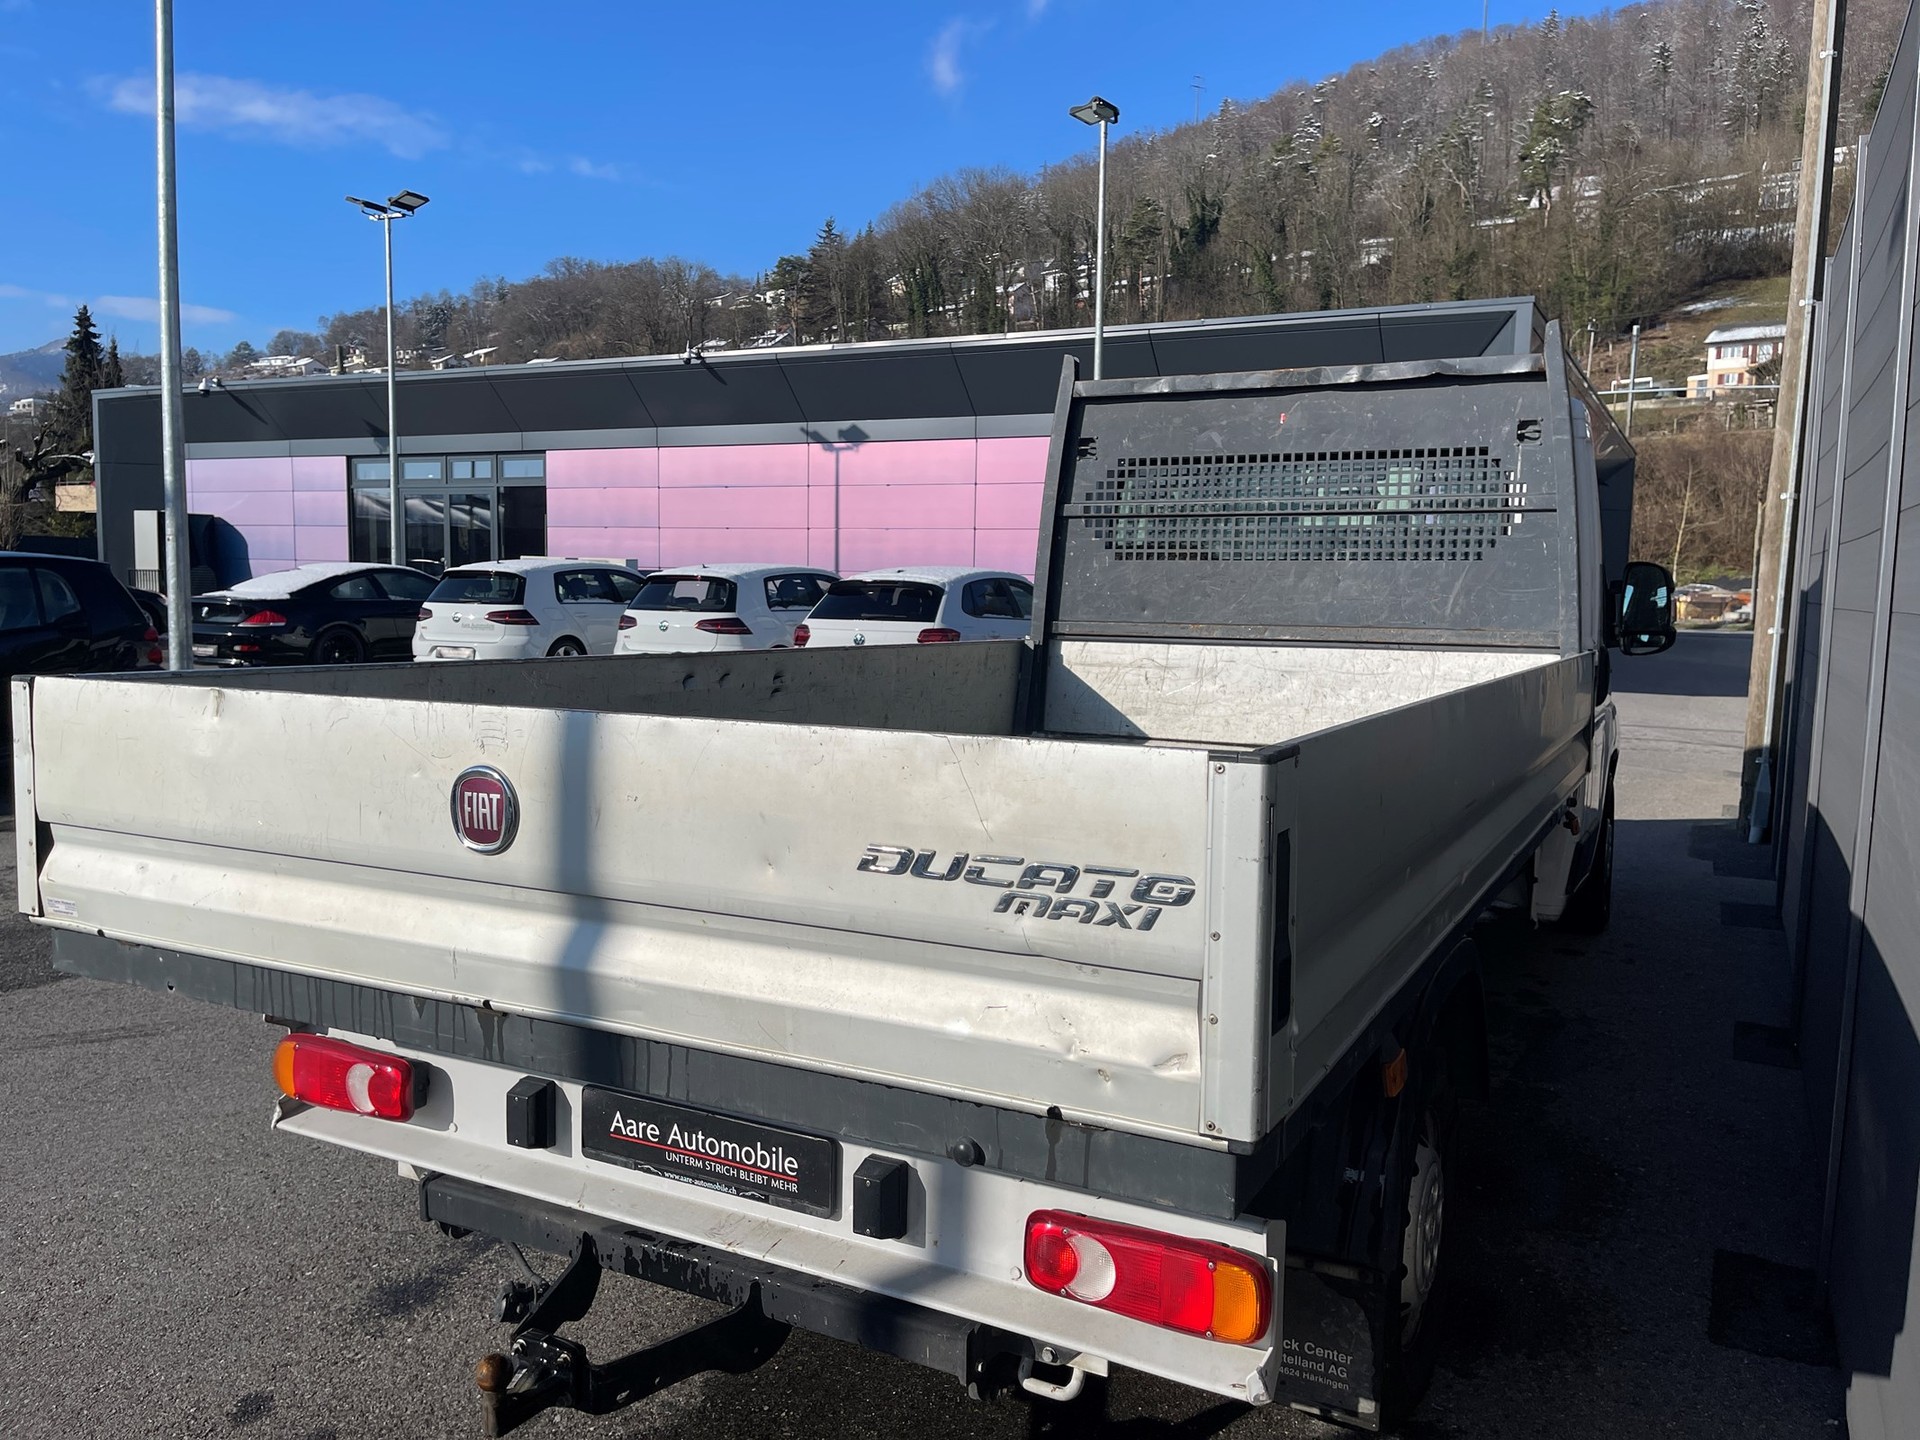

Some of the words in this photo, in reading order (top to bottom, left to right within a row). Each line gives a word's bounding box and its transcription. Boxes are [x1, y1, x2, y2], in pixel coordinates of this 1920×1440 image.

[464, 791, 500, 831] FIAT
[856, 843, 1196, 907] DUCATO
[993, 890, 1162, 931] MAXI
[610, 1110, 660, 1142] Aare
[667, 1123, 799, 1175] Automobile
[664, 1171, 737, 1195] www.aare-automobile.ch
[666, 1152, 703, 1169] UNTERM
[705, 1160, 737, 1177] STRICH
[740, 1169, 768, 1186] BLEIBT
[771, 1179, 798, 1193] MEHR
[1304, 1342, 1353, 1365] Center
[1328, 1364, 1348, 1378] AG
